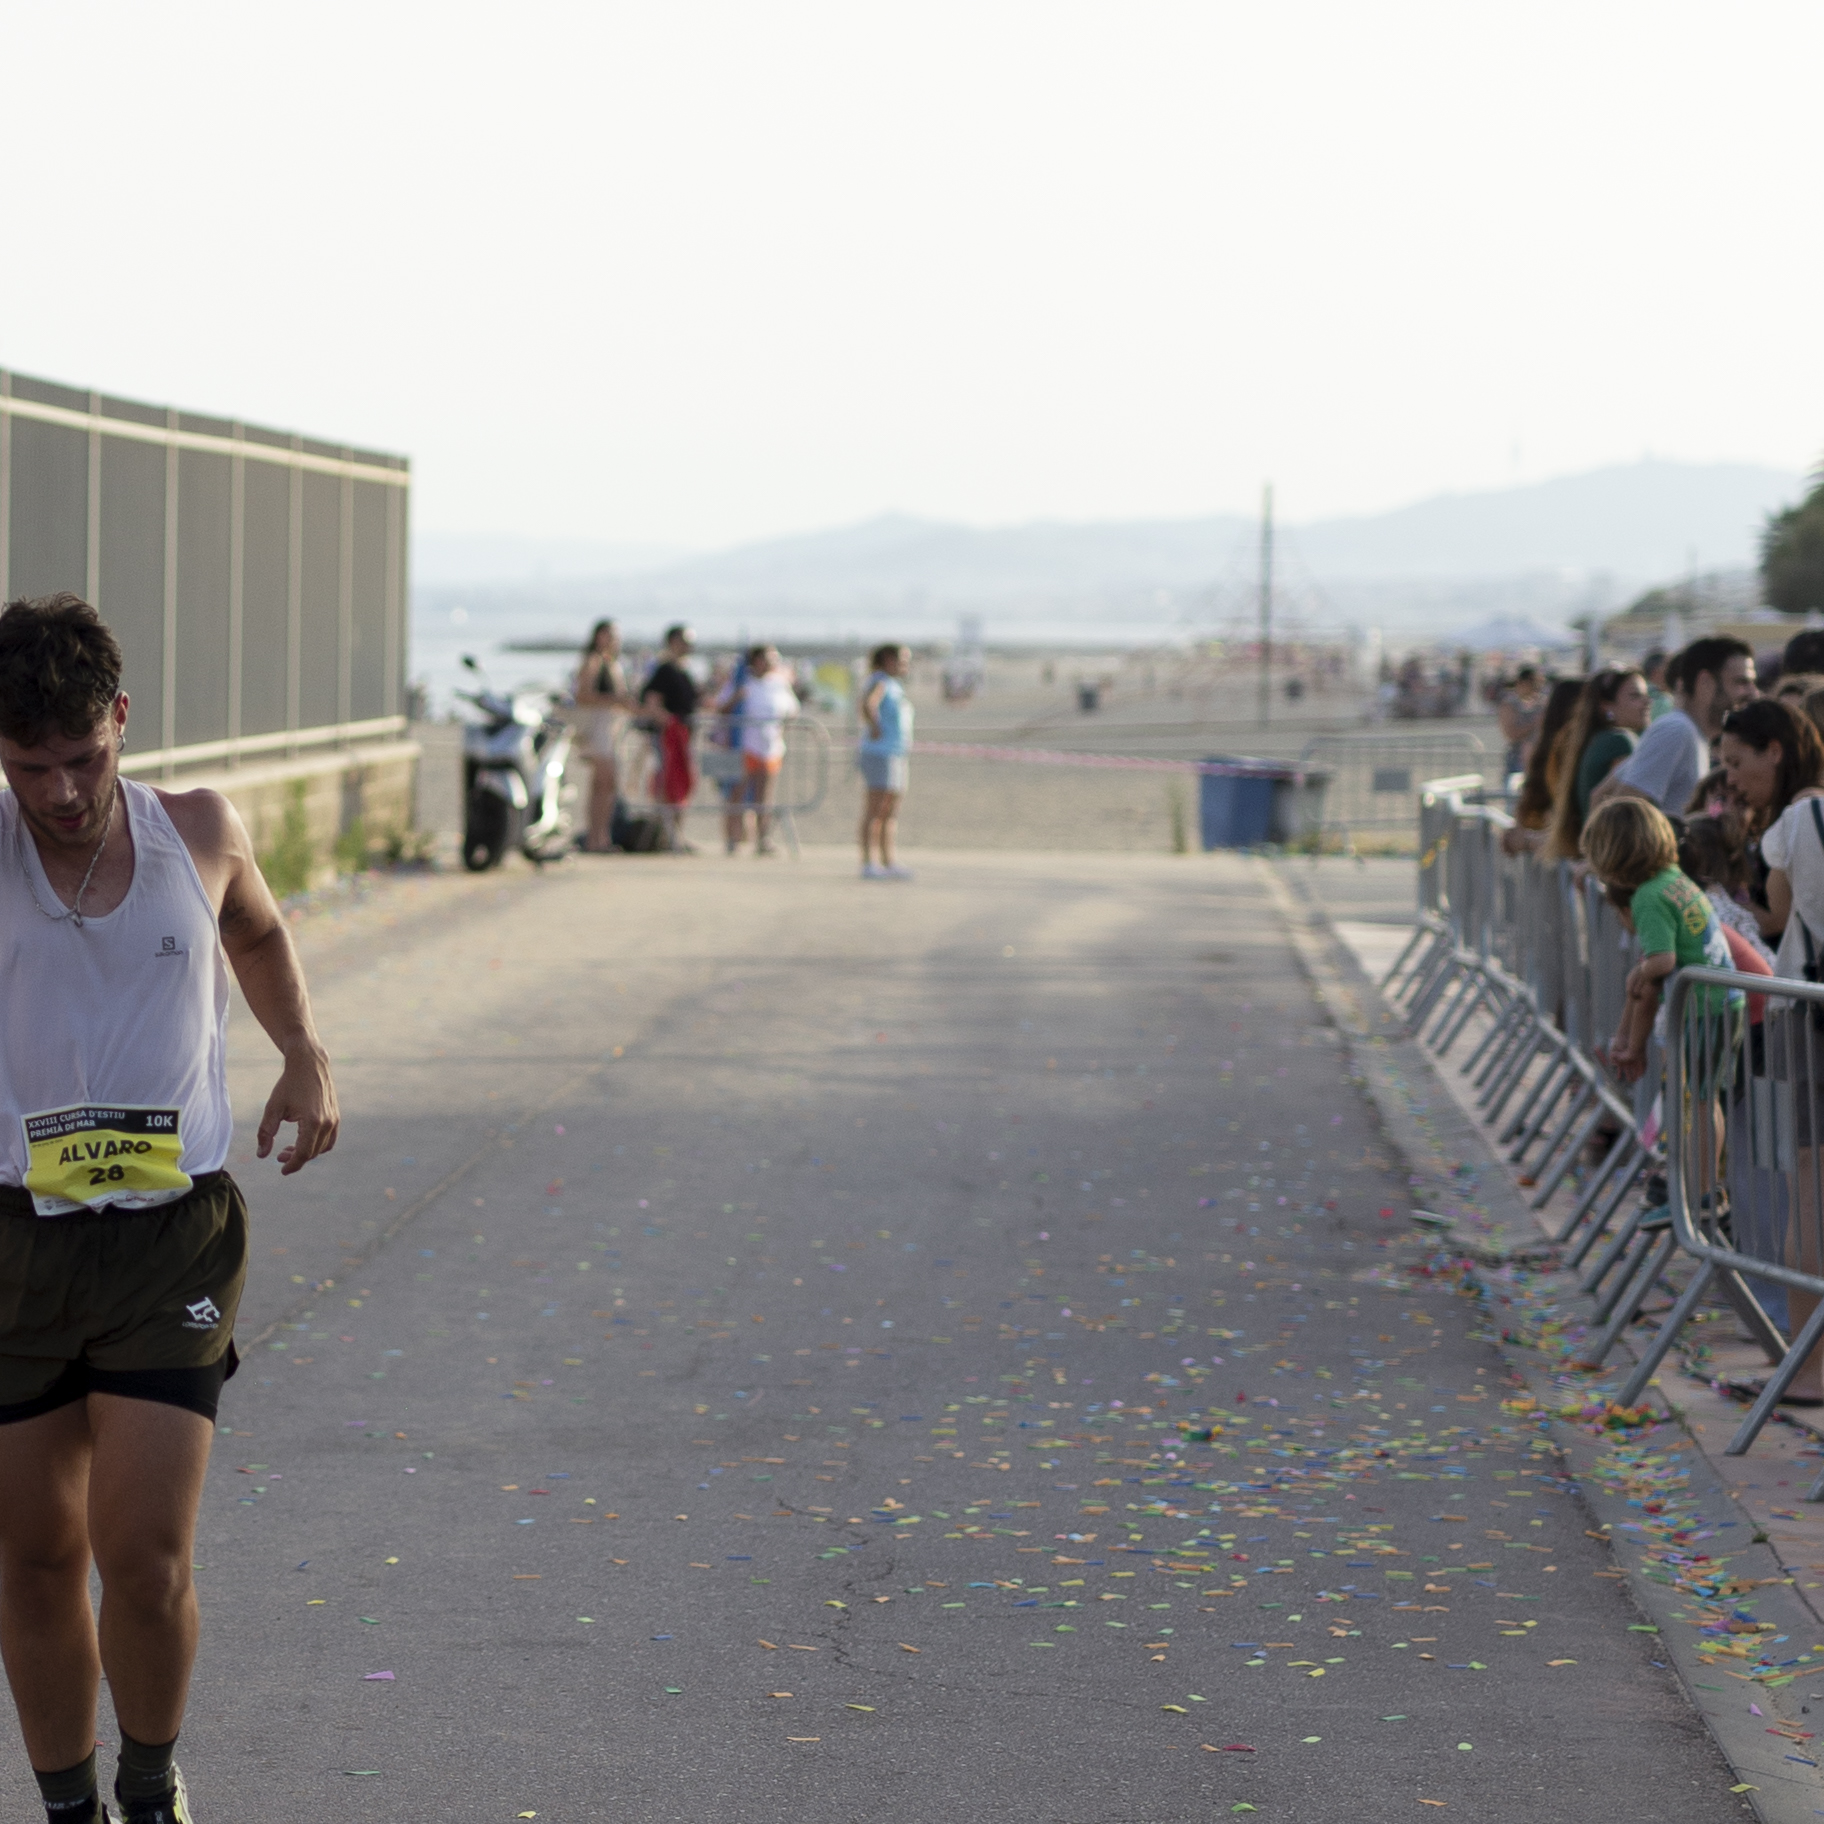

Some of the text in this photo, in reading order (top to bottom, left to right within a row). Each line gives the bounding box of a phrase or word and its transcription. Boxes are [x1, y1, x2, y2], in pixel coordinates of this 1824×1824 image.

[28, 1110, 126, 1129] XXVIII CURSA D'ESTIU
[64, 1123, 76, 1131] DE
[76, 1119, 97, 1128] MAR
[146, 1115, 173, 1127] 10K
[59, 1139, 152, 1166] ALVARO
[87, 1164, 125, 1186] 28
